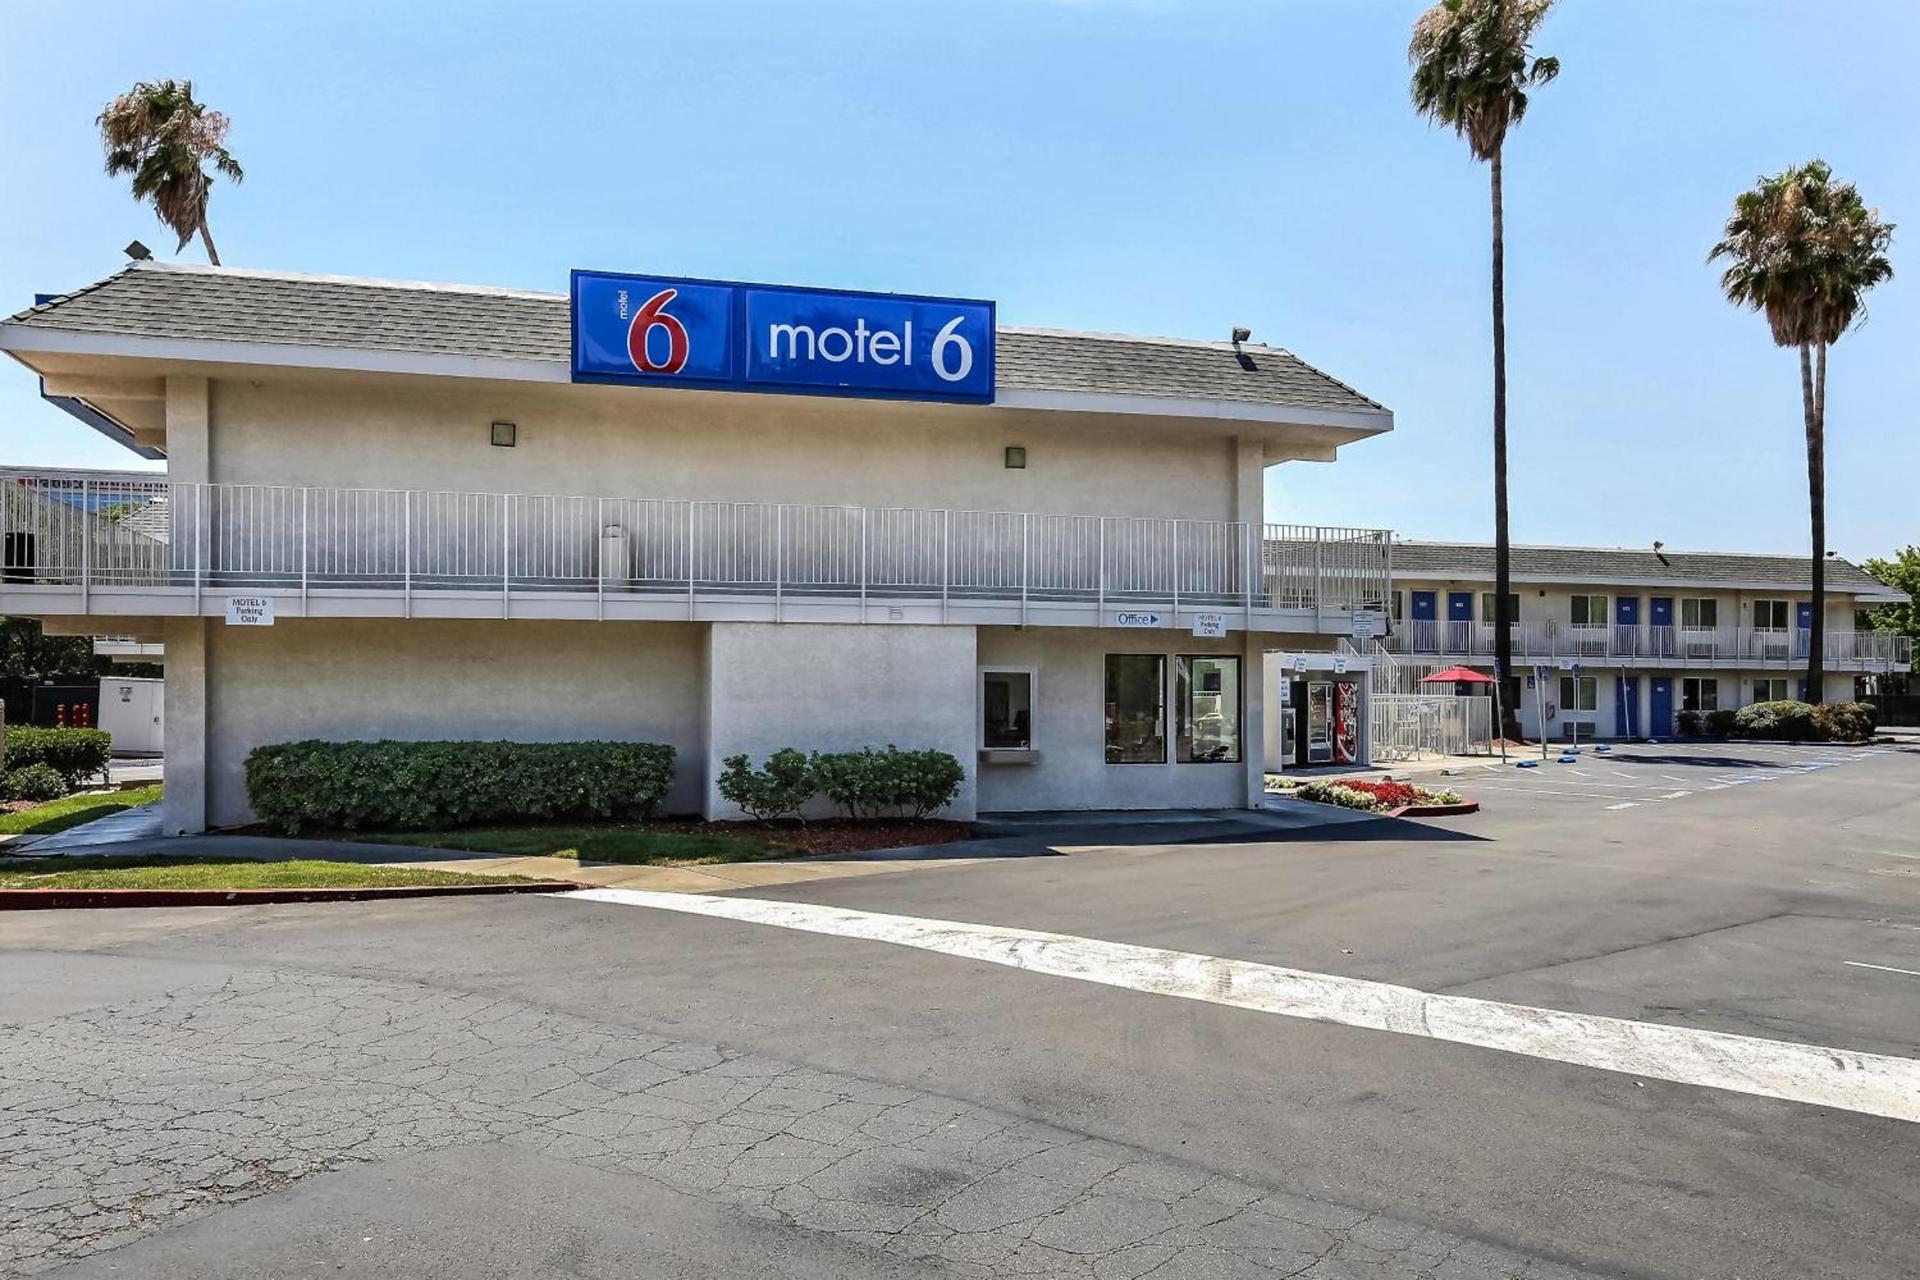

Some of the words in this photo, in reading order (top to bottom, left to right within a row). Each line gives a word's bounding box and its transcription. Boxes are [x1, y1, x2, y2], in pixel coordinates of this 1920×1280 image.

[618, 290, 628, 320] motel
[627, 288, 690, 374] 6
[769, 318, 912, 366] motel
[931, 315, 973, 382] 6
[236, 607, 264, 616] Parking
[241, 615, 258, 623] Only
[1118, 613, 1149, 625] Office
